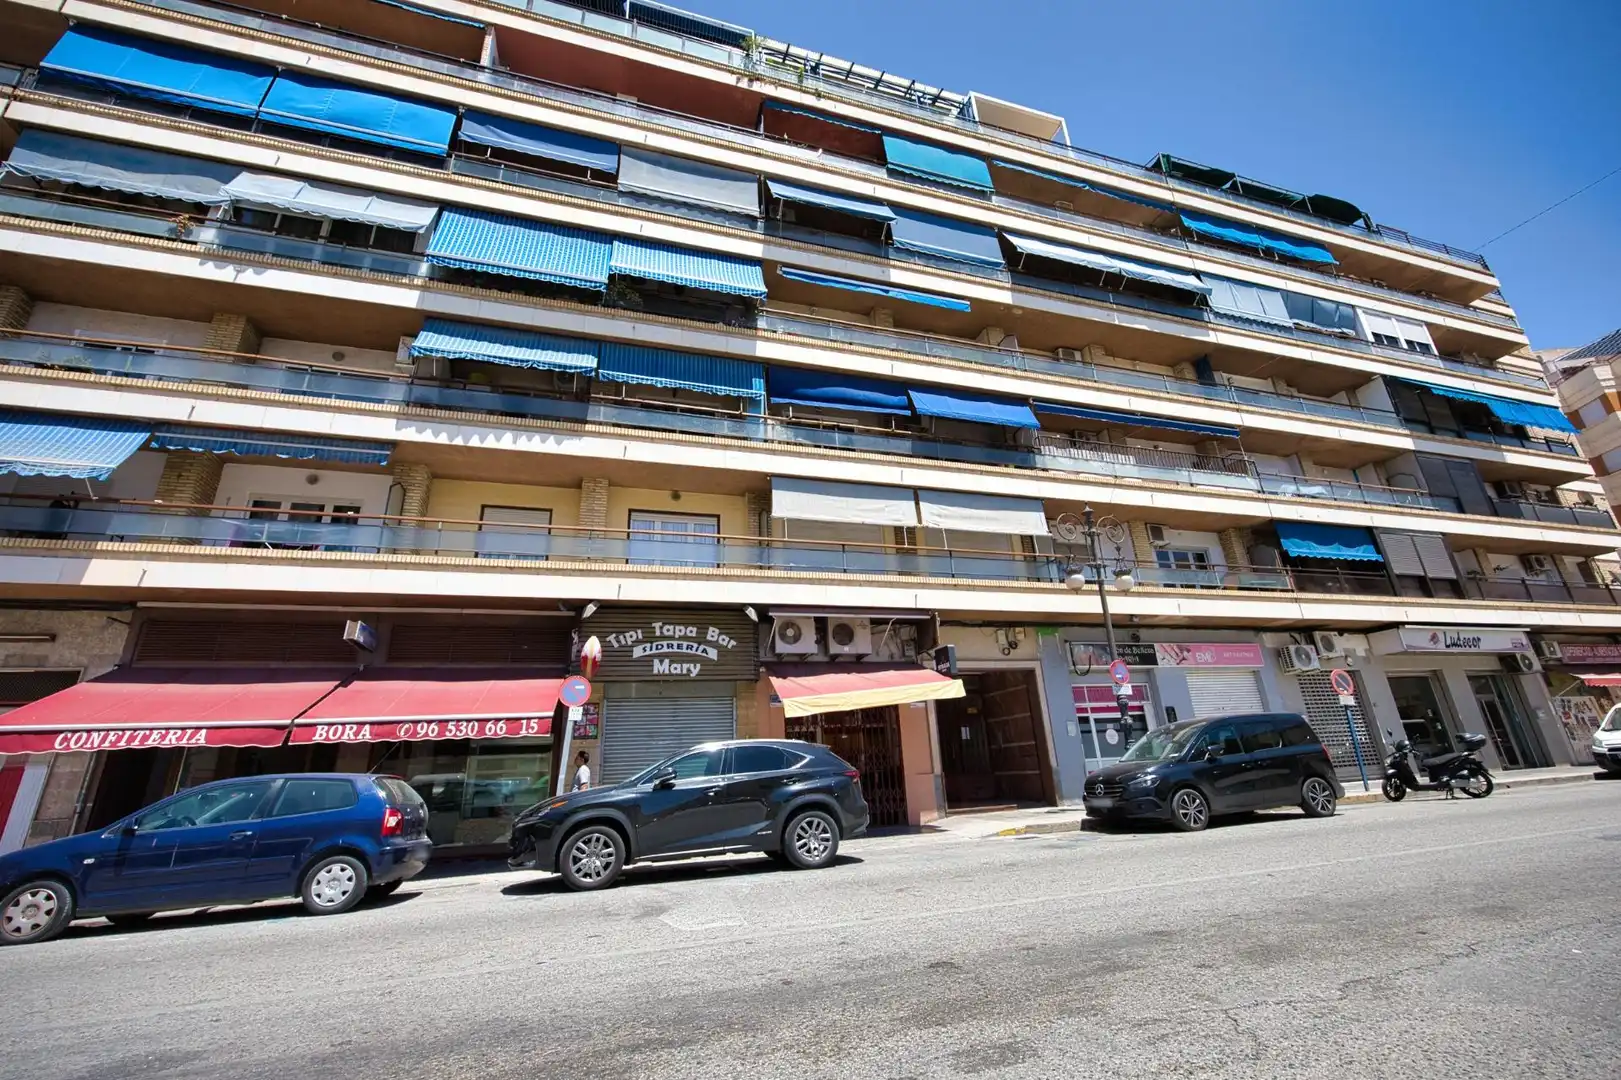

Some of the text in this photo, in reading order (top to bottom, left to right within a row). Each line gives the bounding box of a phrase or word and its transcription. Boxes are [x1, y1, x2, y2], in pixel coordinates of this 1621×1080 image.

[652, 621, 697, 638] Tapa
[706, 626, 737, 649] Bar
[1443, 631, 1481, 649] Ludecor
[652, 658, 701, 677] Mary
[54, 728, 208, 749] CONFITERIA
[312, 718, 539, 740] BORA 96 530 66 15
